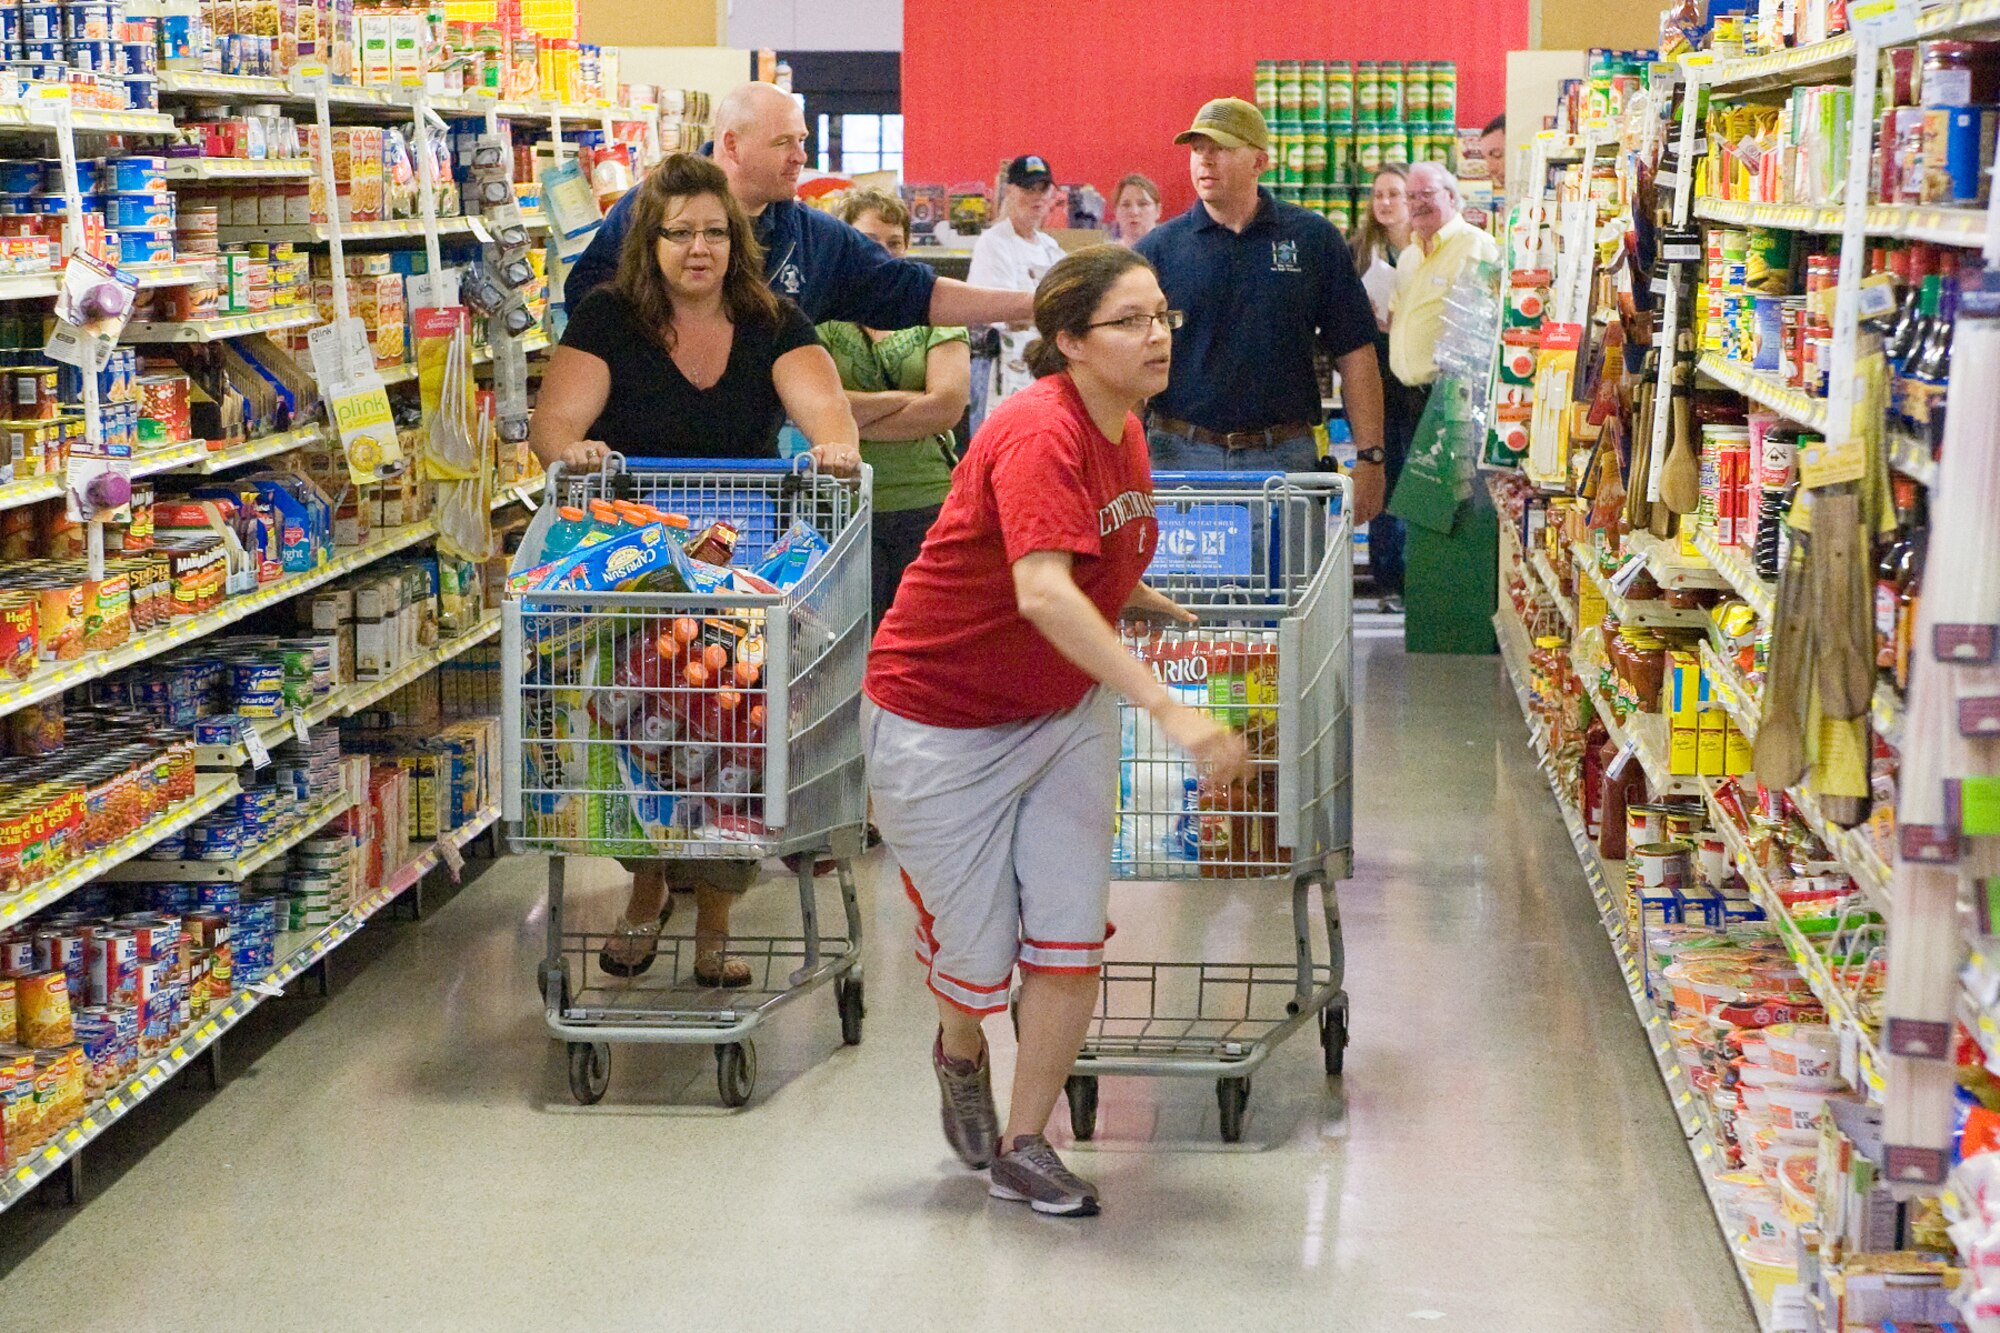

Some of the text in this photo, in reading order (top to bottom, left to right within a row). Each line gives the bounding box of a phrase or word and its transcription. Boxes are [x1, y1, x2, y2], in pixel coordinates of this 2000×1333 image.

[311, 327, 331, 341] plink
[338, 393, 385, 426] plink
[241, 693, 275, 704] StarKist
